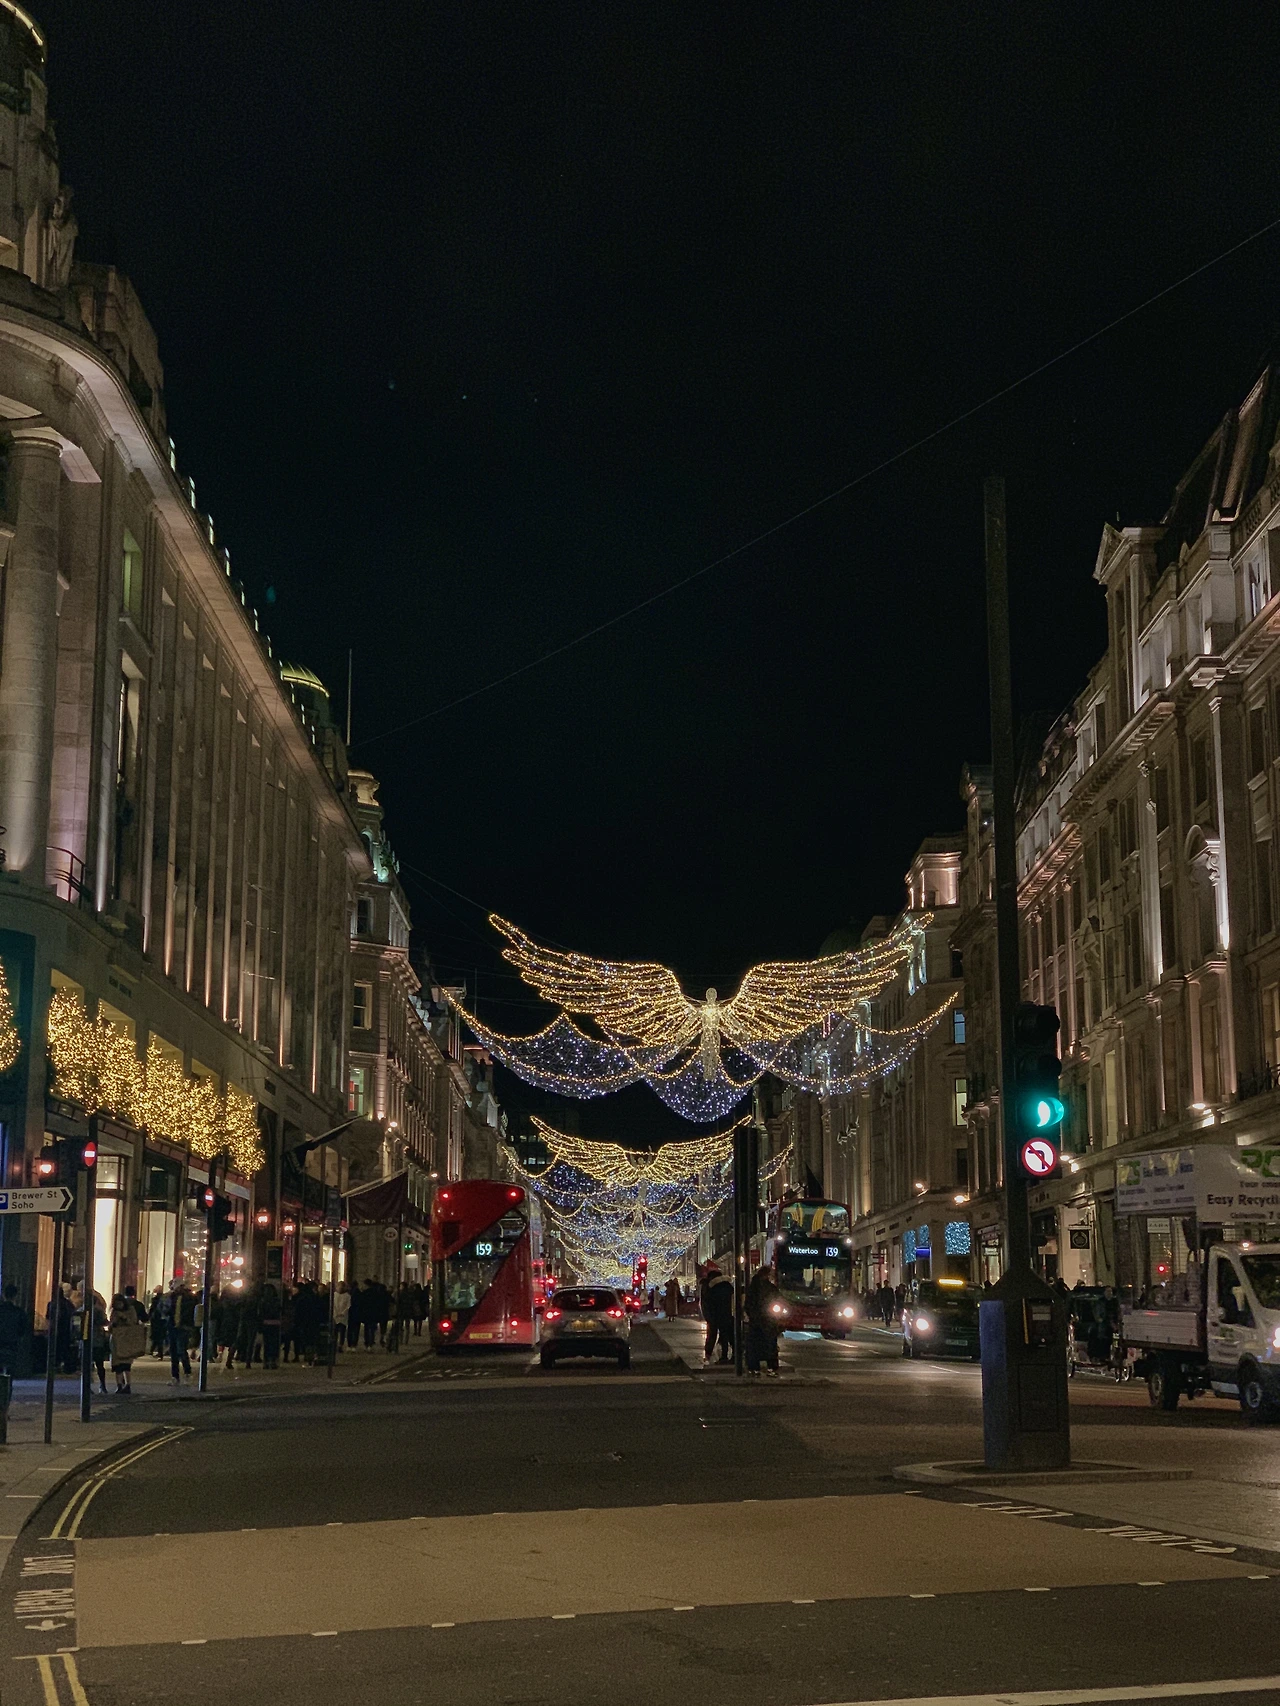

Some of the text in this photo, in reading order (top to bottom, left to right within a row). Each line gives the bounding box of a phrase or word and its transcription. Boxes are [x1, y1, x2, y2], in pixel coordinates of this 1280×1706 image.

[11, 1190, 57, 1200] Brewer St
[1207, 1194, 1234, 1207] Easy
[11, 1201, 34, 1210] Soho
[476, 1243, 492, 1256] 159
[788, 1246, 839, 1257] Waterloo 139
